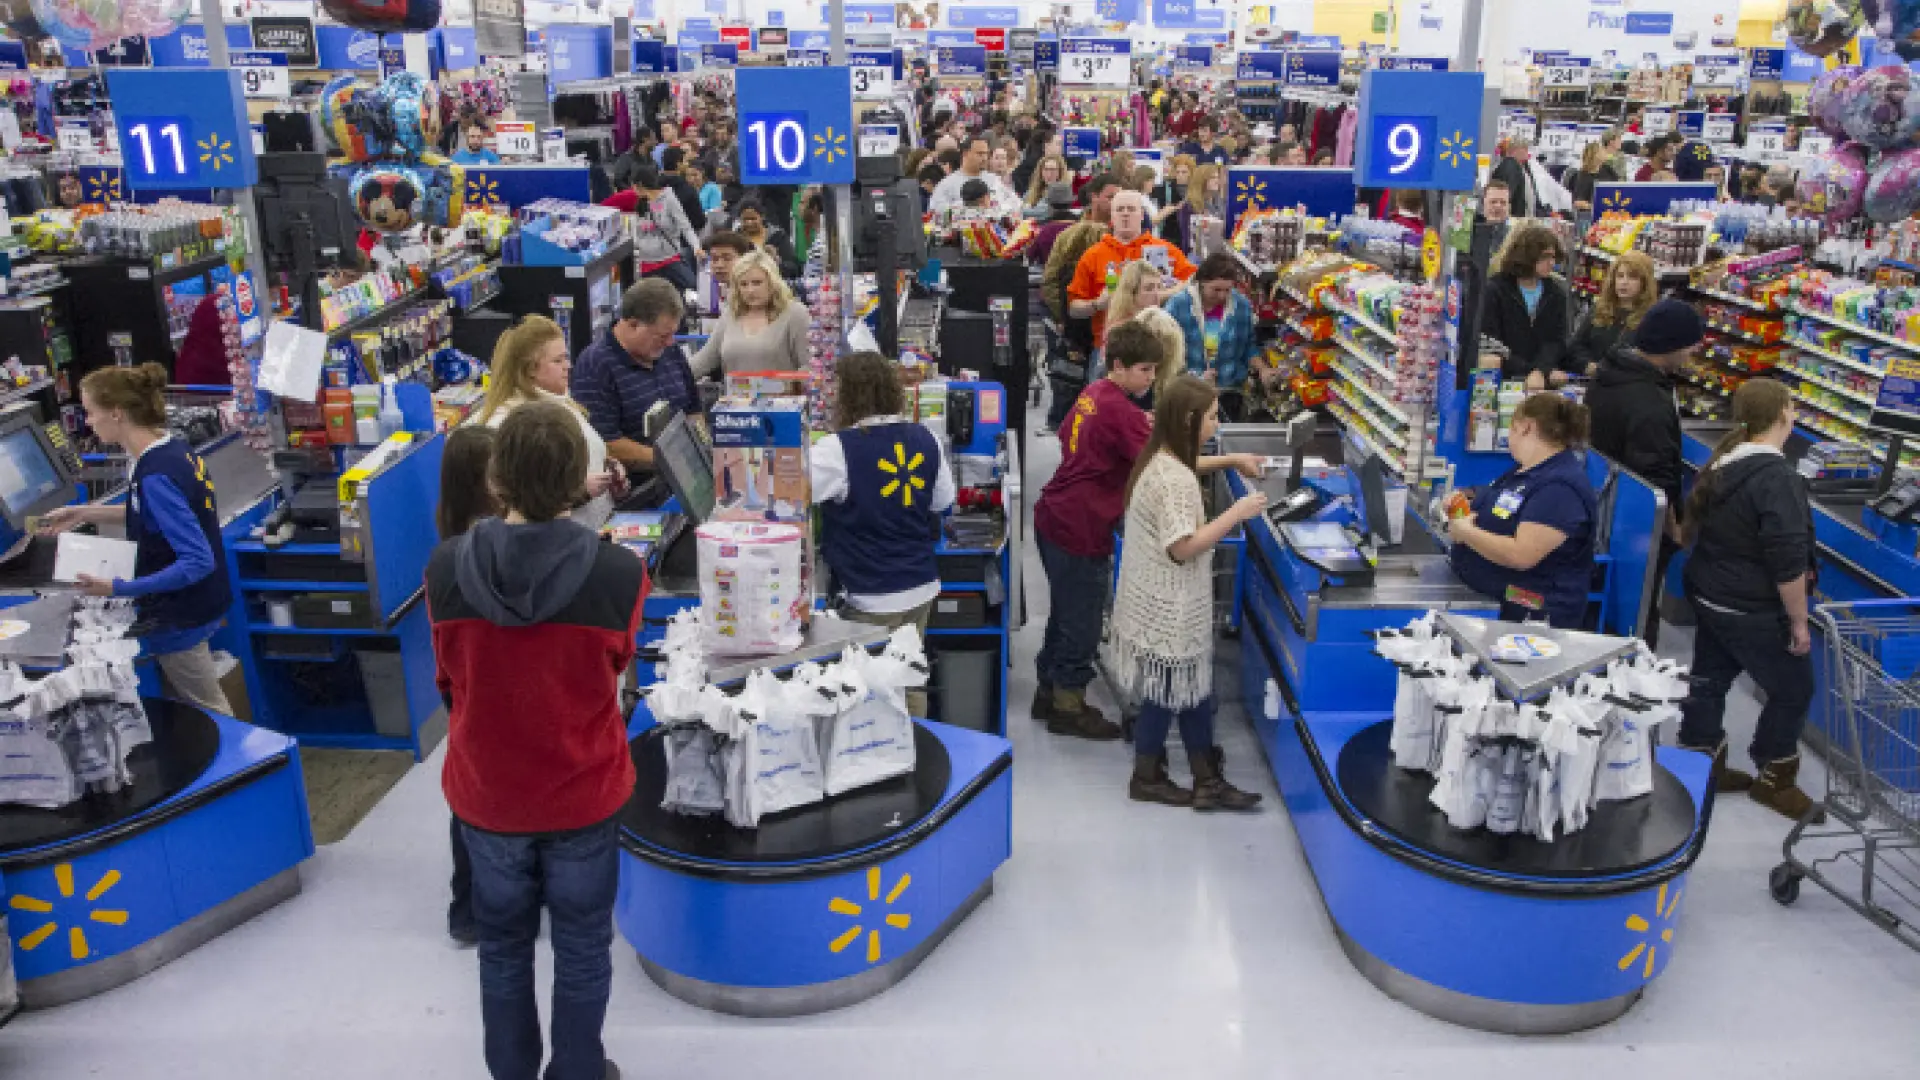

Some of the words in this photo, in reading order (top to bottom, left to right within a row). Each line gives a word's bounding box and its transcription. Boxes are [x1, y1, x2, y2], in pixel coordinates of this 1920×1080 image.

[131, 124, 184, 173] 11
[749, 121, 804, 168] 10
[1388, 124, 1420, 173] 9
[715, 414, 760, 428] Shark
